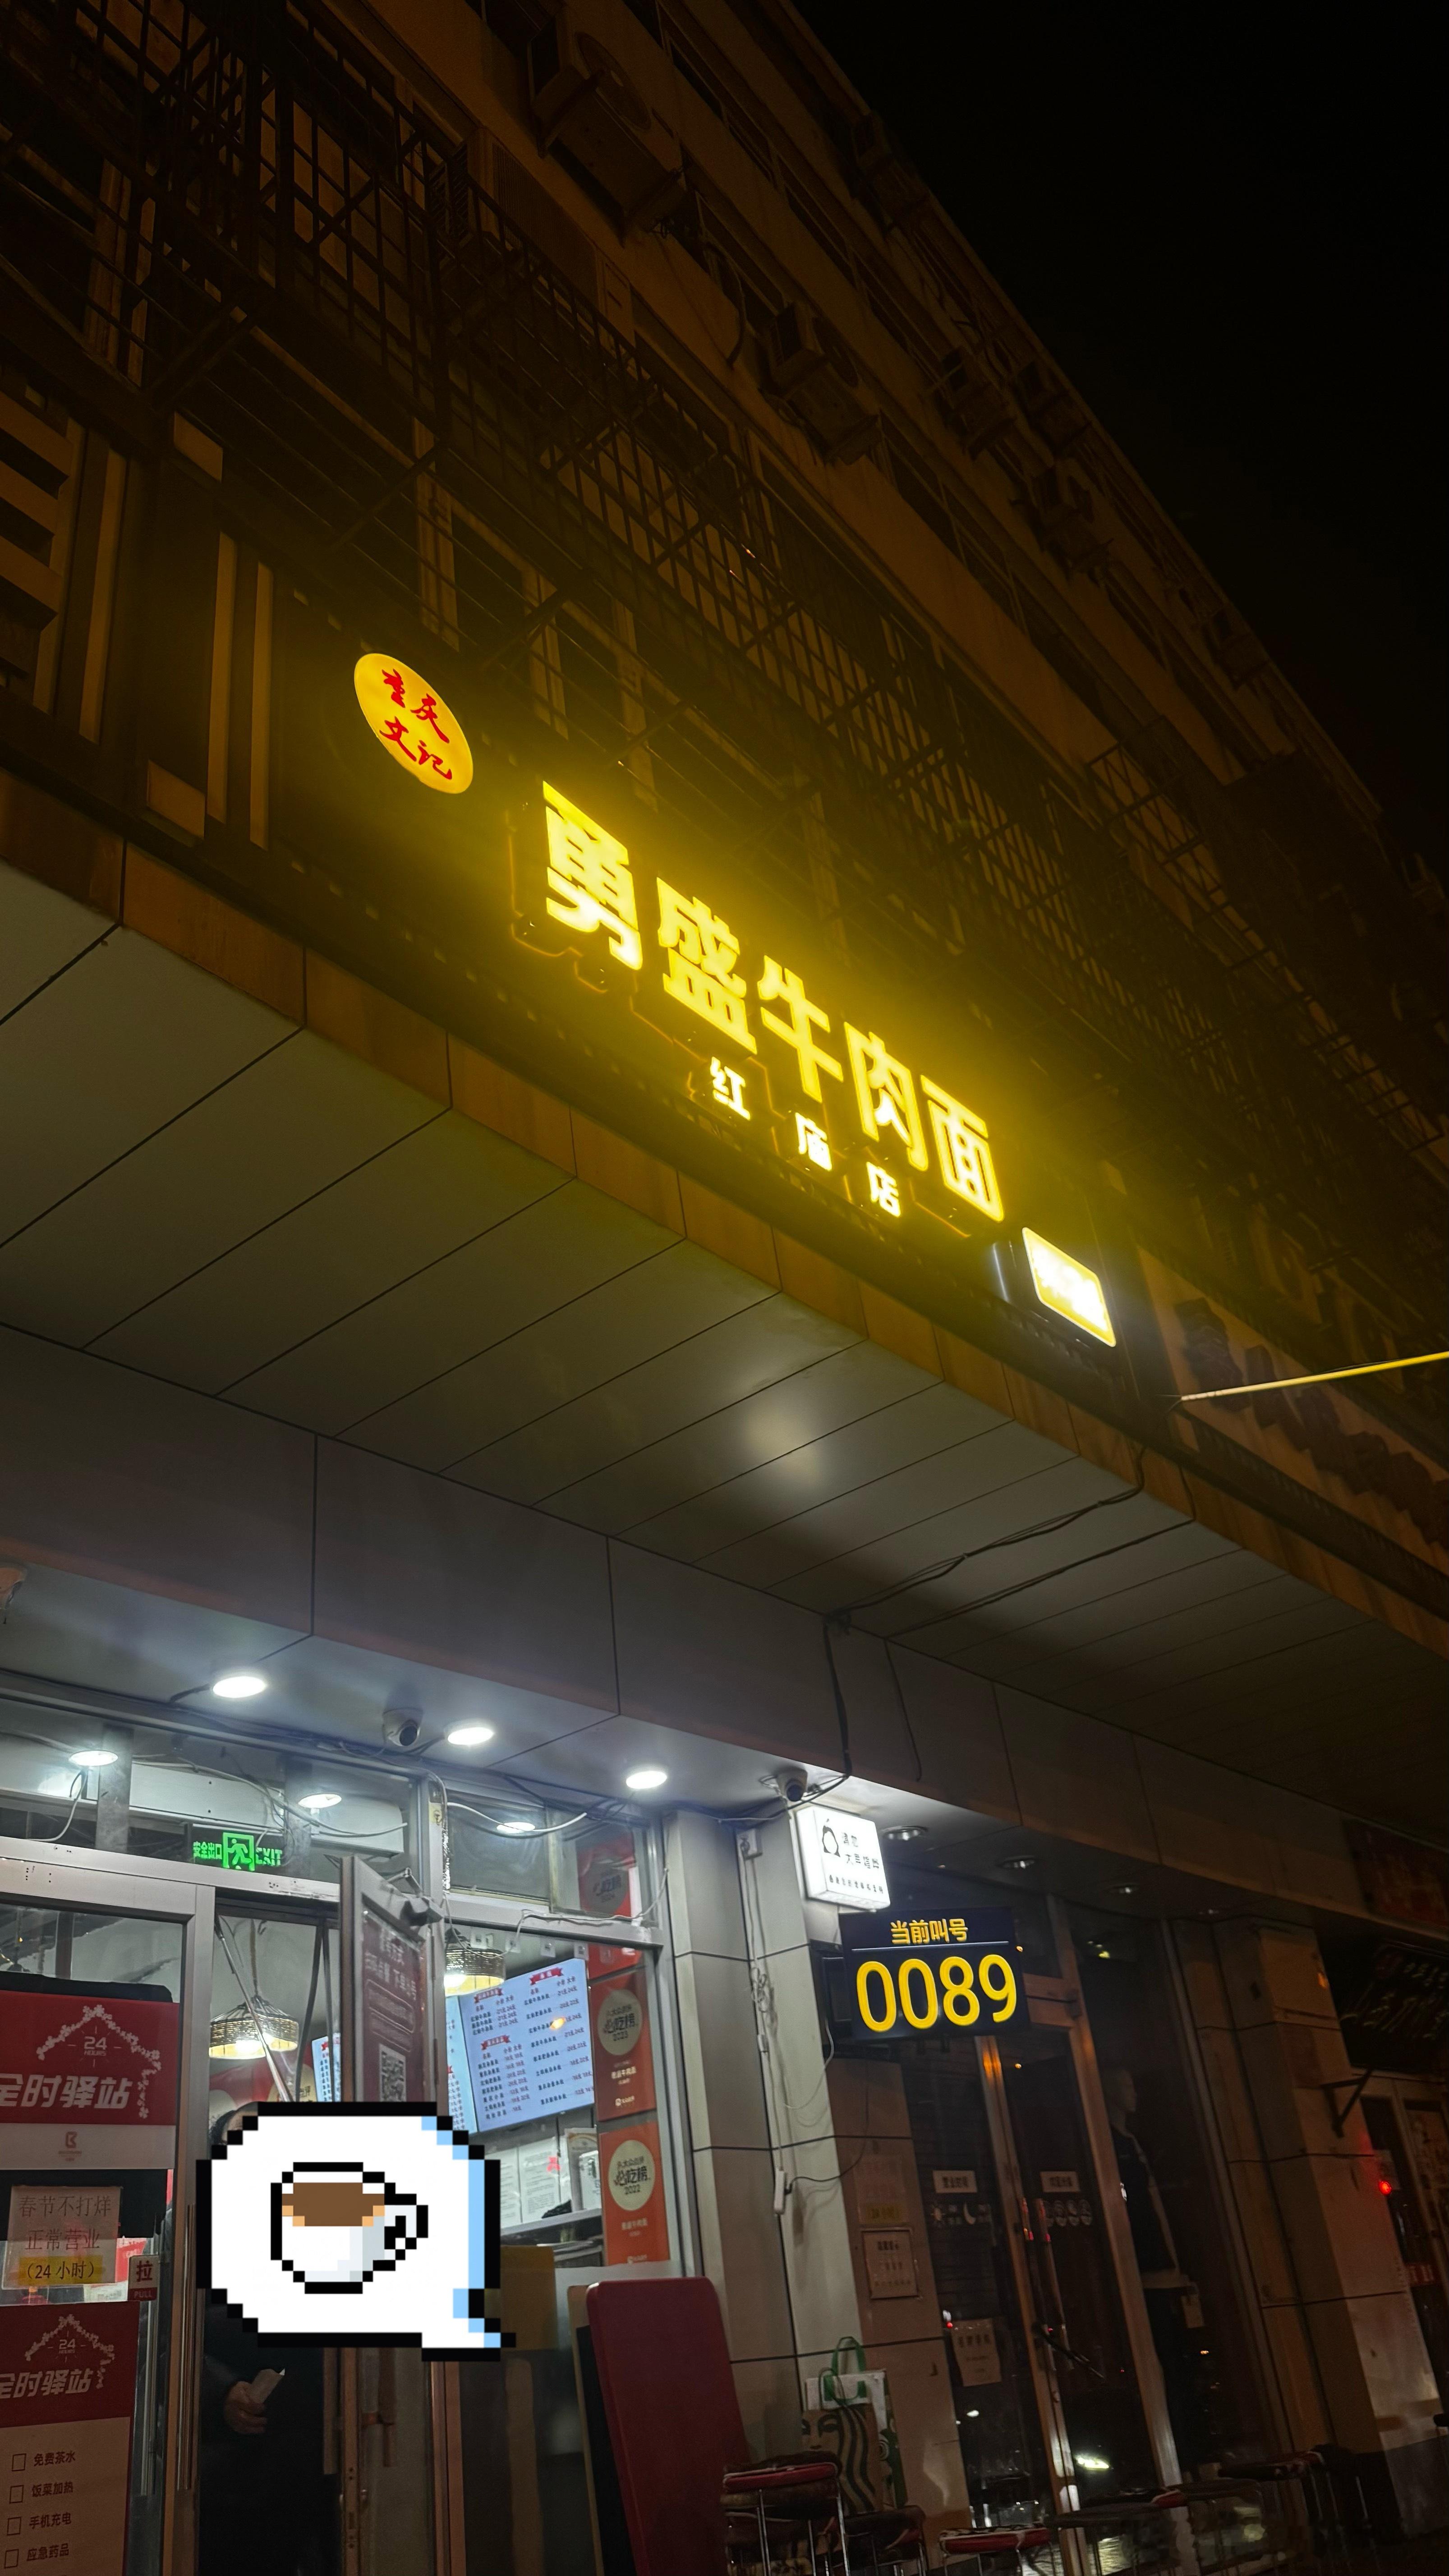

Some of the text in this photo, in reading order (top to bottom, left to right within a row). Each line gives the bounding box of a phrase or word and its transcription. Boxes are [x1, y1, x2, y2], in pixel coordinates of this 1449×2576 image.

[379, 716, 452, 780] 文记
[542, 780, 1005, 1223] 勇盛牛肉面
[710, 1056, 901, 1218] 红庙店
[193, 1841, 222, 1860] 安全出口
[256, 1847, 282, 1866] EXIT
[890, 1918, 969, 1945] 当前叫号
[856, 1954, 1018, 2033] 0089
[84, 2036, 107, 2050] 24
[19, 2195, 111, 2218] 春节不打烊
[25, 2228, 100, 2251] 正常营业
[136, 2260, 153, 2282] 拉
[133, 2290, 152, 2298] PULL
[58, 2338, 76, 2350] 24
[33, 2451, 76, 2466] 免费茶水
[31, 2481, 74, 2498] 饭菜加热
[29, 2512, 72, 2530] 手机充电
[26, 2543, 69, 2562] 应急药品
